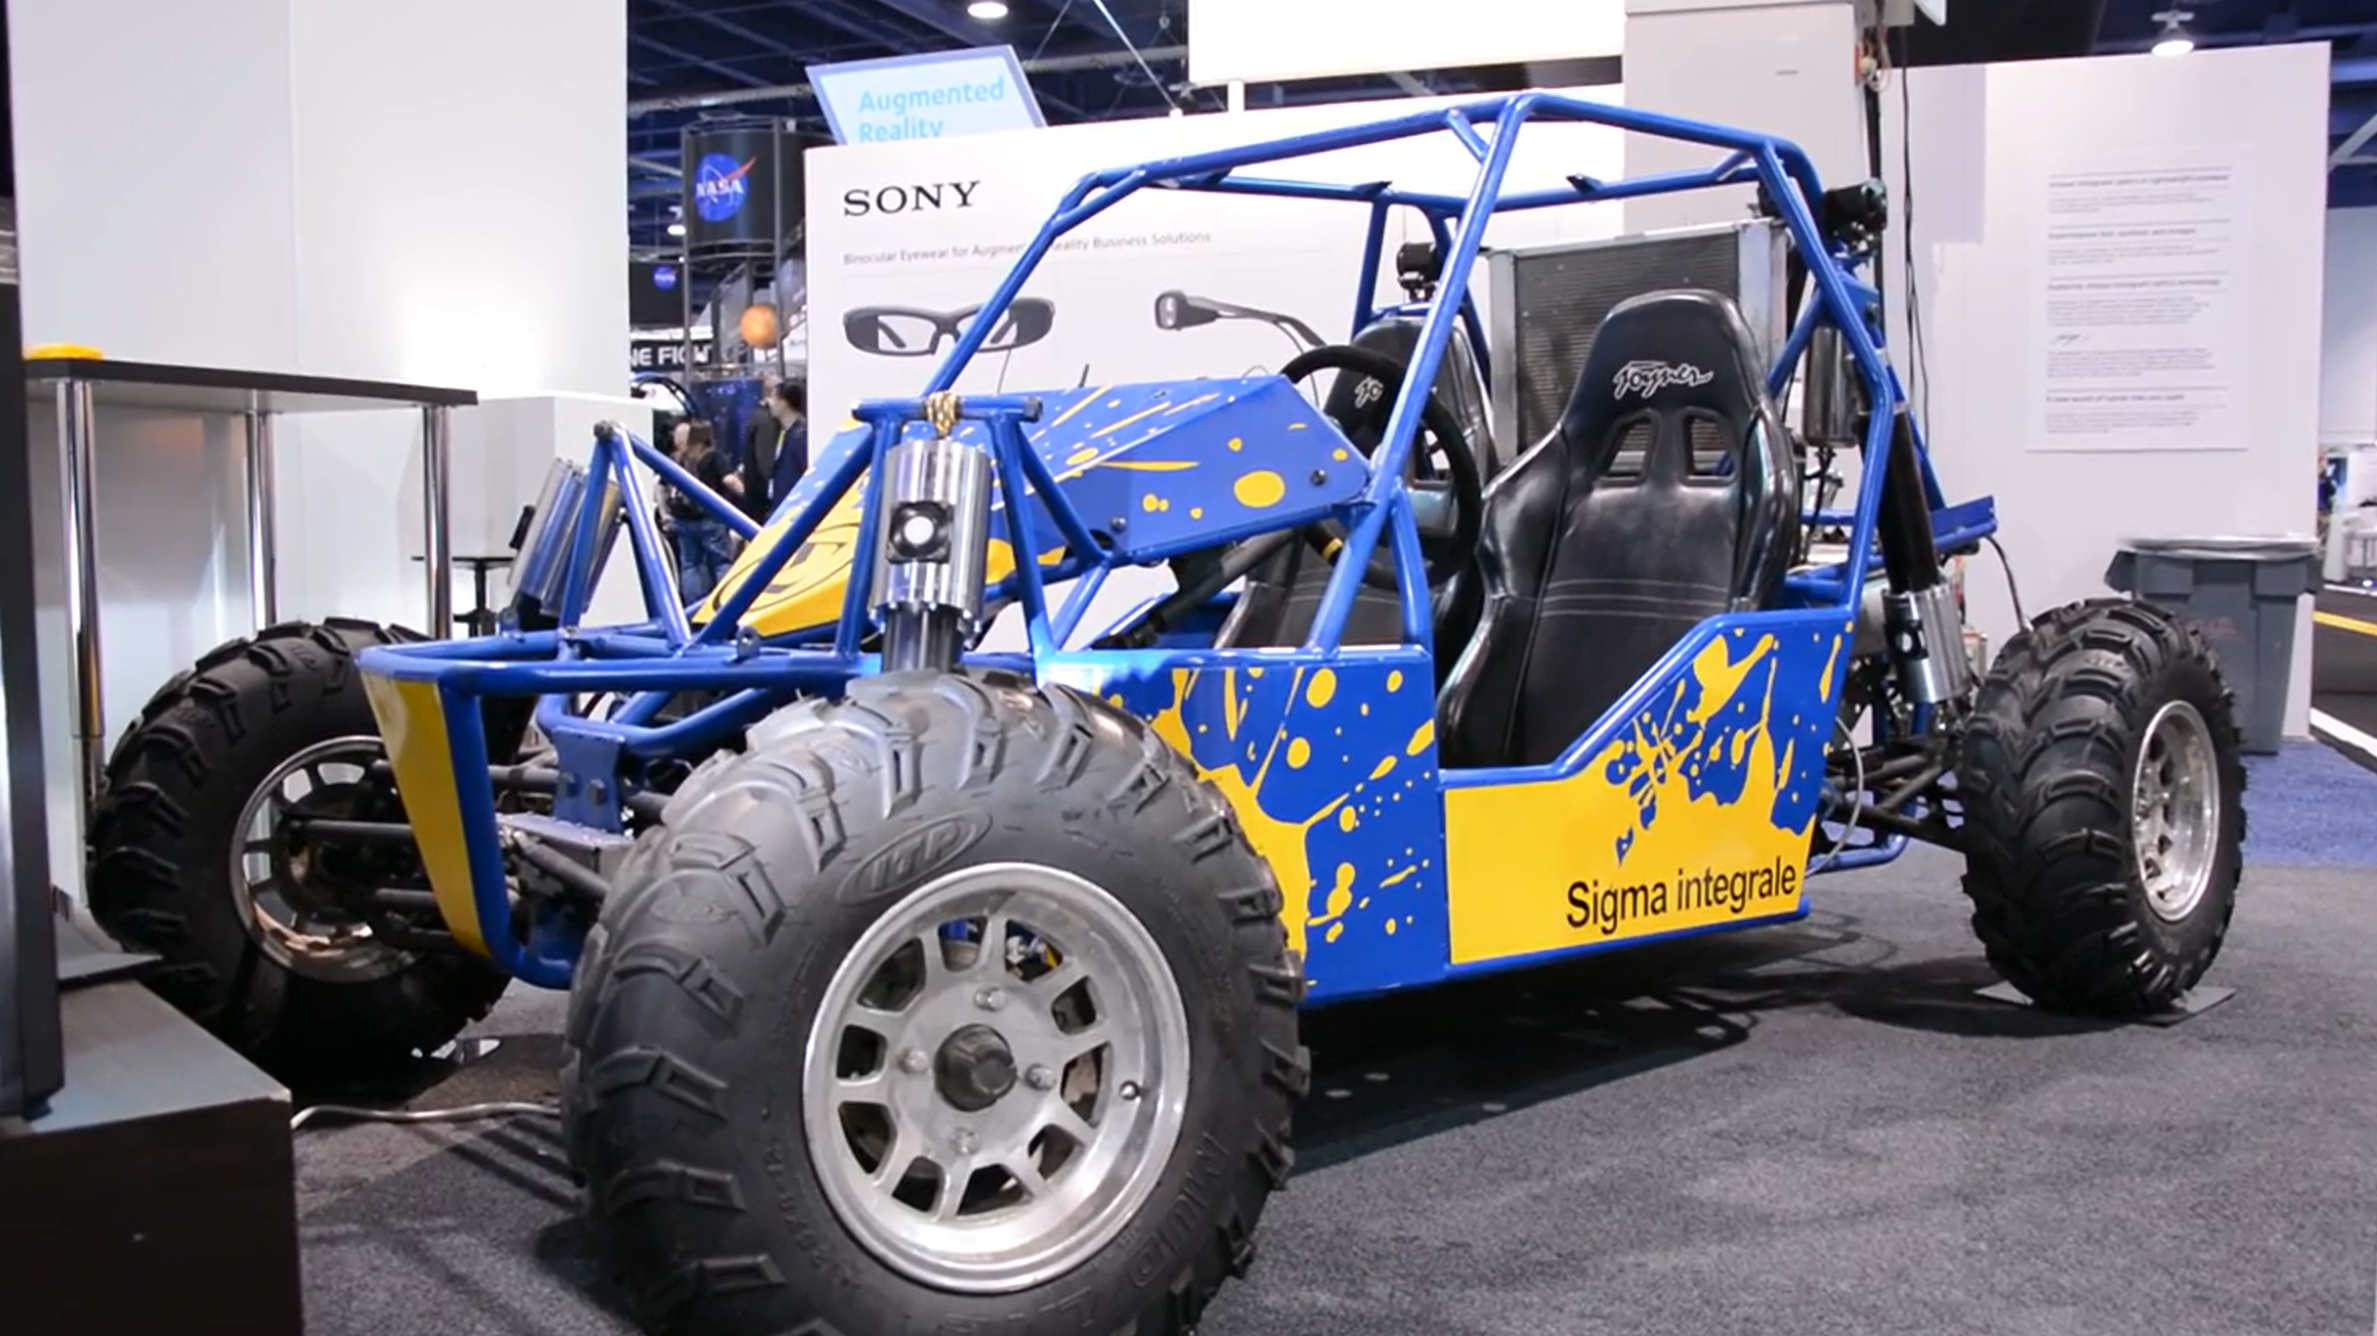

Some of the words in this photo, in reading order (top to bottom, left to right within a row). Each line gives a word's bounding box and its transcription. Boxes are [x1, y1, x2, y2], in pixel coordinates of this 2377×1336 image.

[858, 75, 1005, 115] Augmented
[858, 117, 944, 143] Reality
[695, 179, 745, 198] NASA
[843, 180, 981, 217] SONY
[844, 251, 897, 265] Binocular
[900, 248, 949, 263] Eyewear
[952, 245, 969, 258] for
[1052, 238, 1089, 251] eality
[1093, 236, 1148, 249] Business
[1151, 231, 1211, 245] Solutions
[1566, 879, 1668, 935] Sigma
[1676, 856, 1797, 914] integrale
